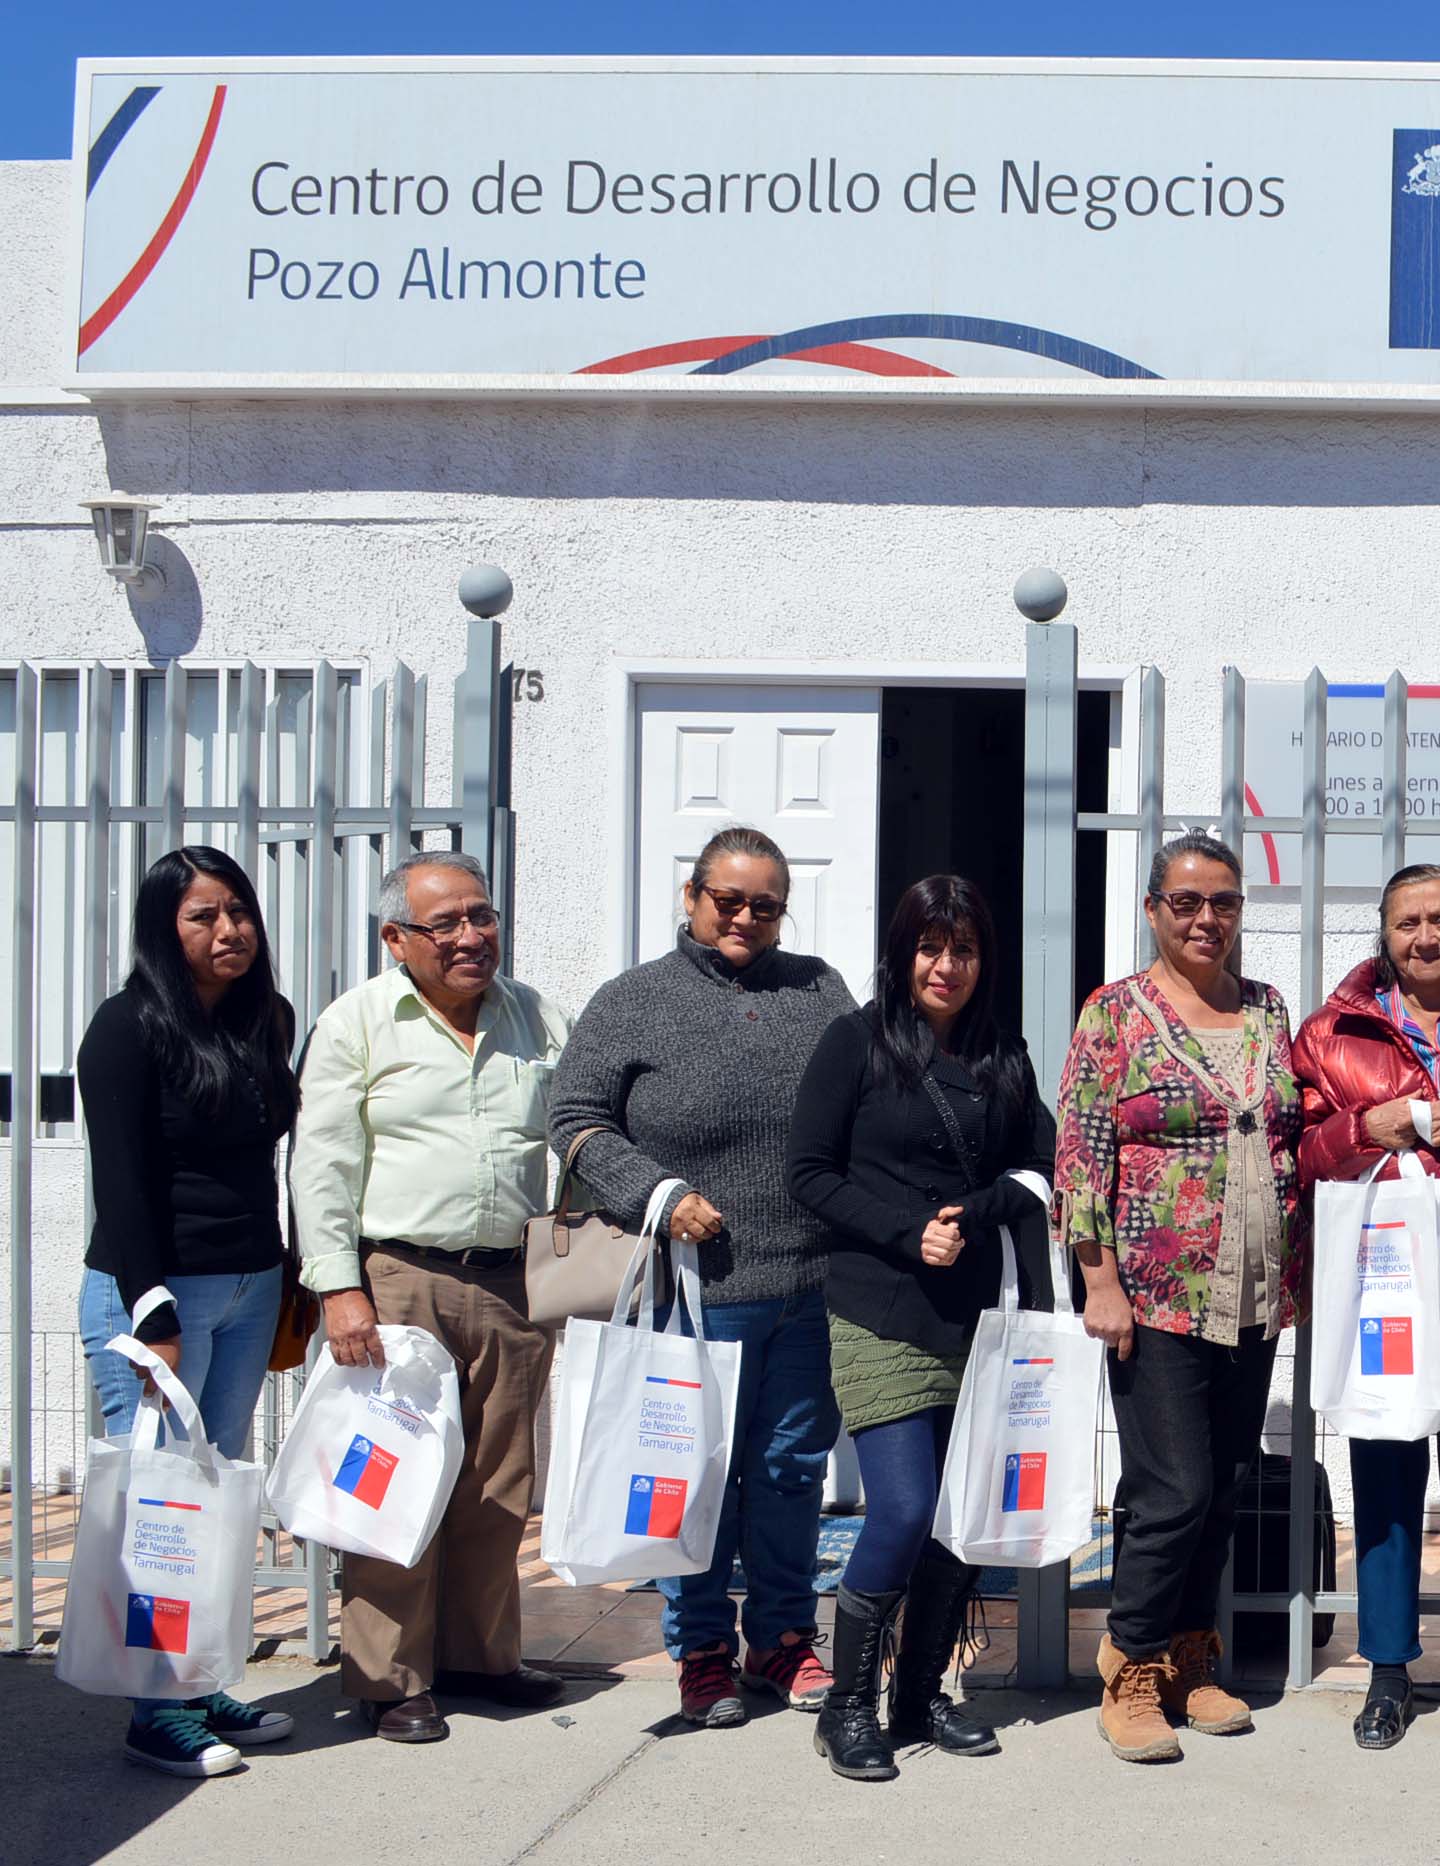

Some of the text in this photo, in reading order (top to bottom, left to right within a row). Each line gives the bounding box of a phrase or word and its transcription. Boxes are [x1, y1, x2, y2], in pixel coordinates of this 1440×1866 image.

[251, 157, 1286, 231] Centro de Desarrollo de Negocios
[247, 246, 647, 301] Pozo Almonte
[1291, 731, 1366, 748] HARIO
[1325, 776, 1366, 791] unes
[1372, 776, 1383, 791] a
[1354, 801, 1365, 815] a
[1385, 1244, 1396, 1253] de
[1357, 1253, 1400, 1263] Desarrollo
[1358, 1279, 1412, 1292] Tamarugal
[642, 1398, 686, 1411] Centro de
[367, 1400, 420, 1434] Tamarugal
[640, 1408, 687, 1422] Desarrollo
[1008, 1415, 1050, 1428] Tamarugal
[639, 1419, 696, 1435] de Negocios
[638, 1435, 694, 1454] Tamarugal
[136, 1519, 185, 1534] Centro de
[134, 1528, 187, 1544] Desarrollo
[133, 1540, 196, 1557] de Negocios
[133, 1555, 195, 1576] Tamarugal
